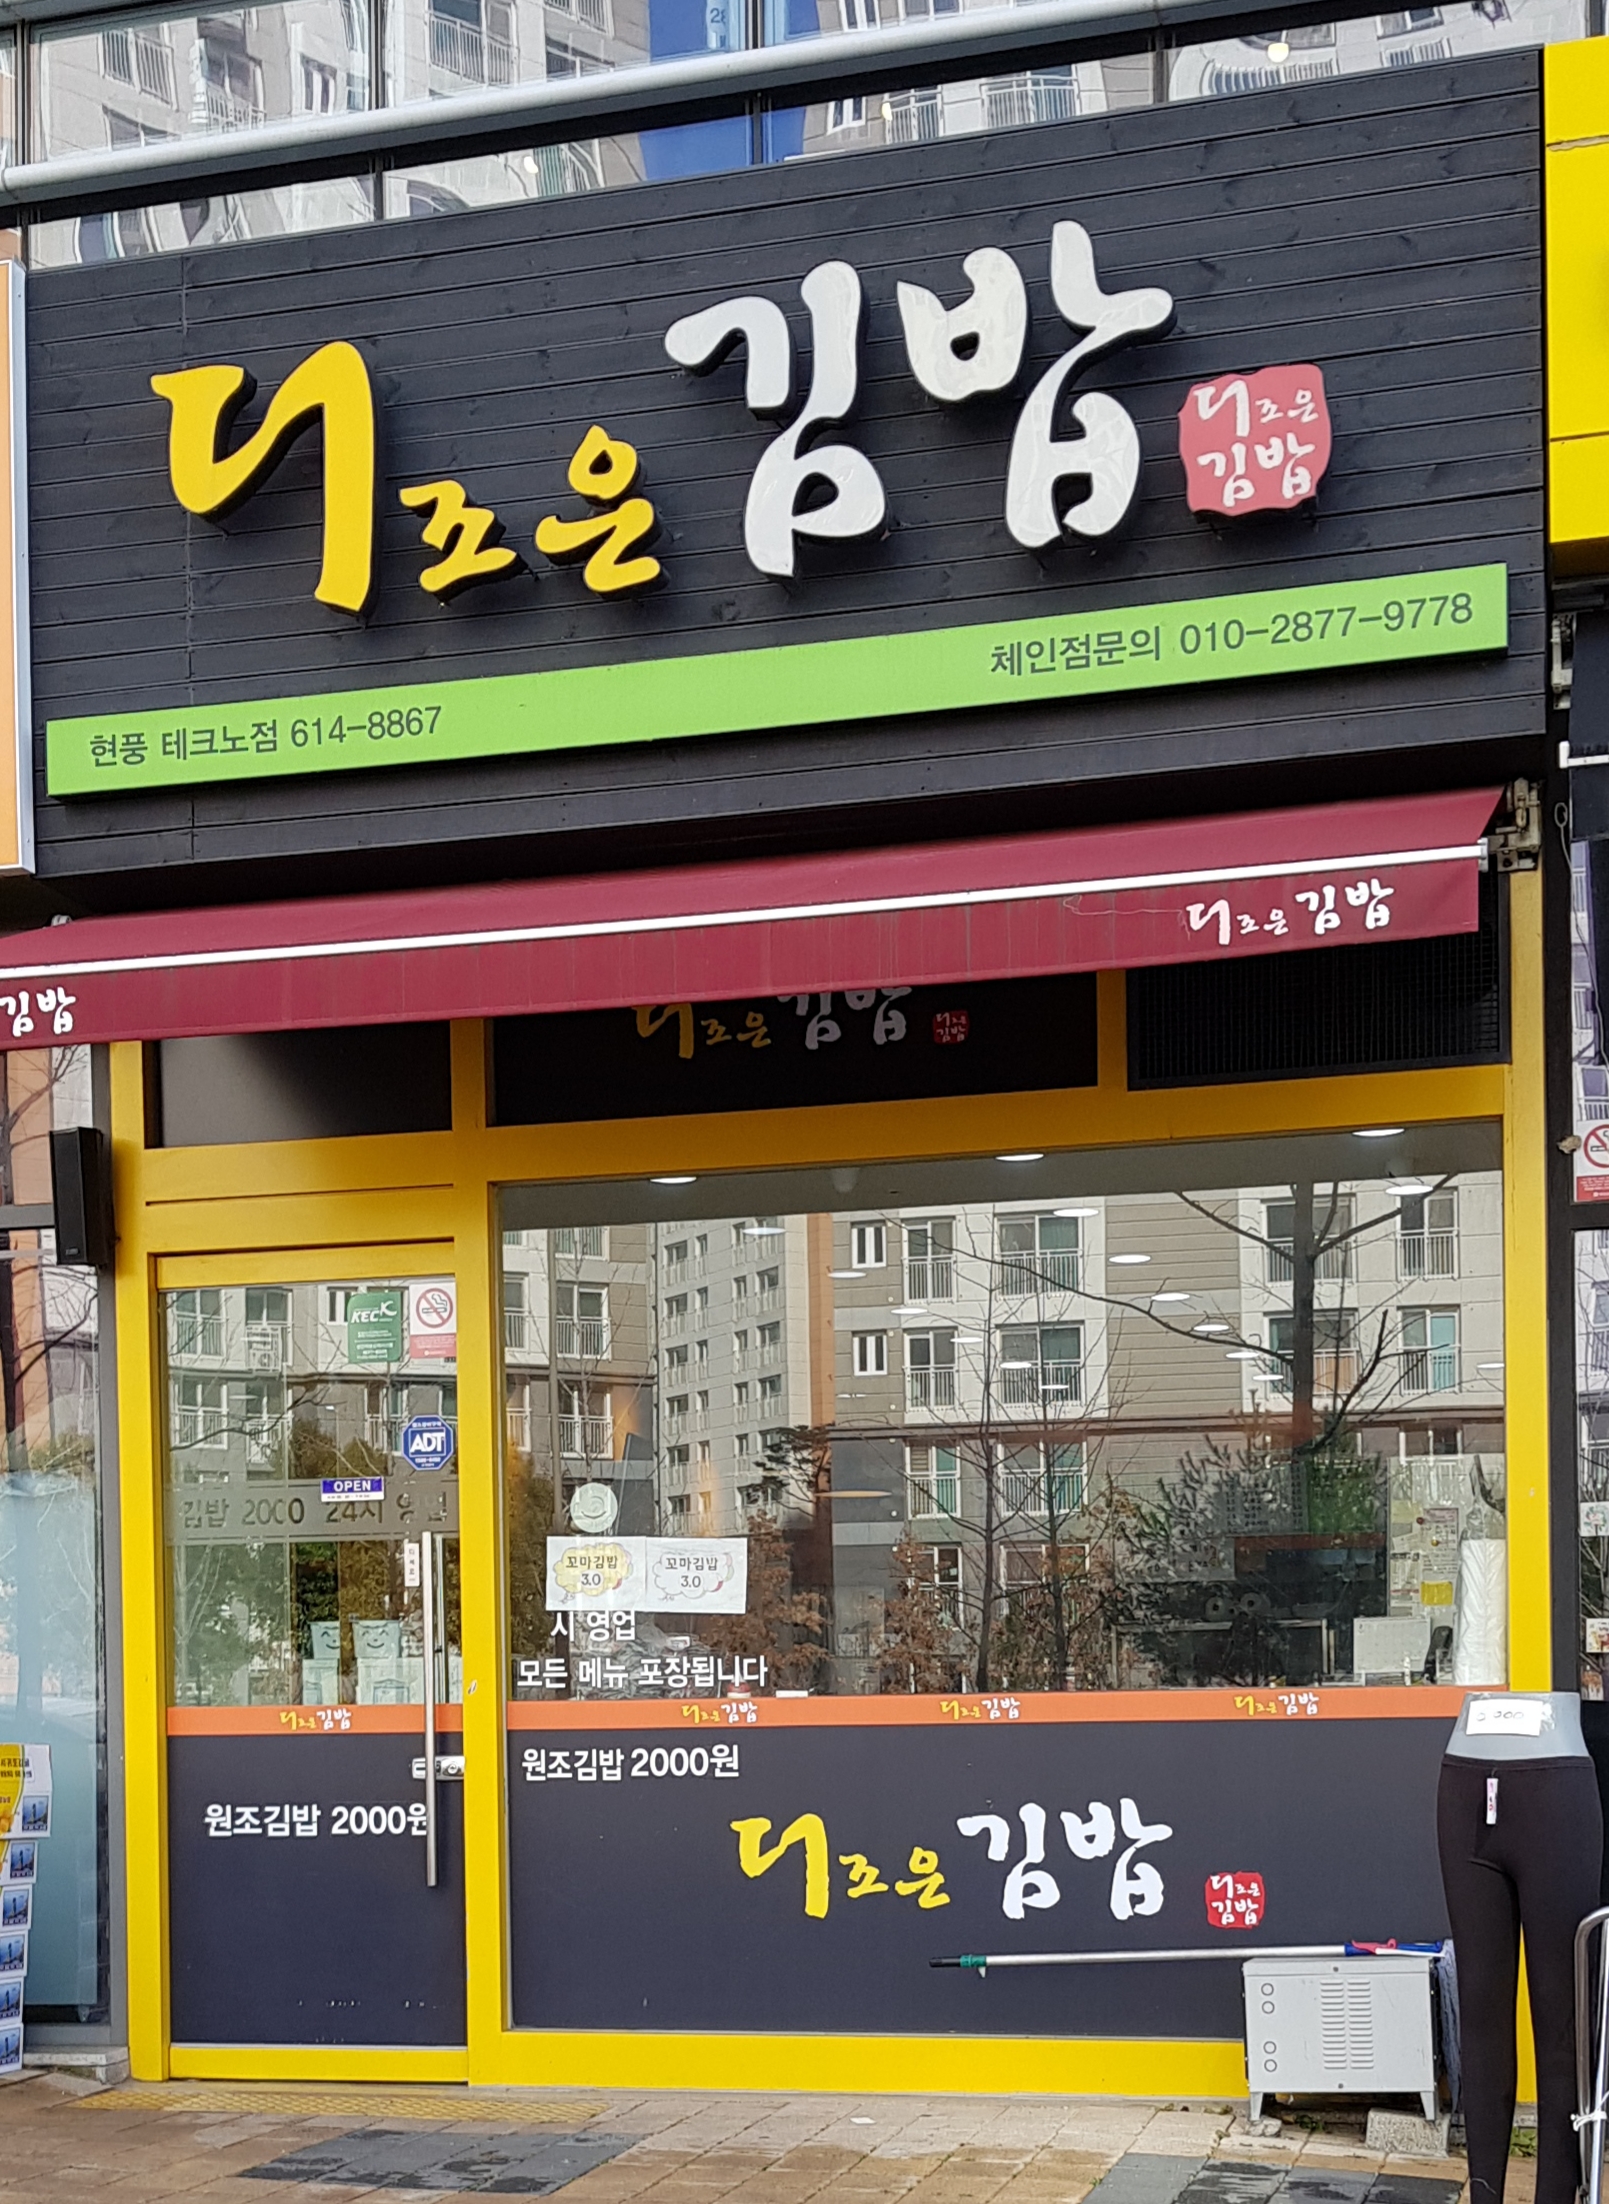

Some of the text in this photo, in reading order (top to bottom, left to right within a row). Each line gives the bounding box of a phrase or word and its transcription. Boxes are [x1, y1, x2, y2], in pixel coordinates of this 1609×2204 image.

[152, 221, 1173, 611] 더조은 김밥
[1193, 380, 1319, 439] 더조은
[1196, 429, 1316, 508] 김밥
[990, 593, 1473, 676] 체인점문의 010-2877-9778
[90, 706, 442, 768] 현풍 테크노점 614-8867
[1186, 878, 1395, 945] 더조은 김밥
[0, 986, 77, 1038] 김밥
[409, 1432, 446, 1453] ADT
[333, 1480, 372, 1492] OPEN
[565, 1555, 618, 1570] 꼬마김밥
[665, 1557, 719, 1572] 꼬마김밥
[580, 1573, 602, 1587] 3.0
[680, 1575, 702, 1589] 3.0
[551, 1610, 637, 1642] 시 영업
[517, 1655, 768, 1689] 모든 메뉴 포장됩니다
[316, 1708, 352, 1730] 김밥
[720, 1701, 758, 1723] 김밥
[981, 1697, 1021, 1720] 김밥
[1277, 1692, 1319, 1716] 김밥
[521, 1744, 740, 1781] 원조김밥 2000원
[204, 1804, 321, 1837] 원조김밥
[731, 1798, 1173, 1920] 더조은 김밥
[1211, 1894, 1259, 1926] 김밥
